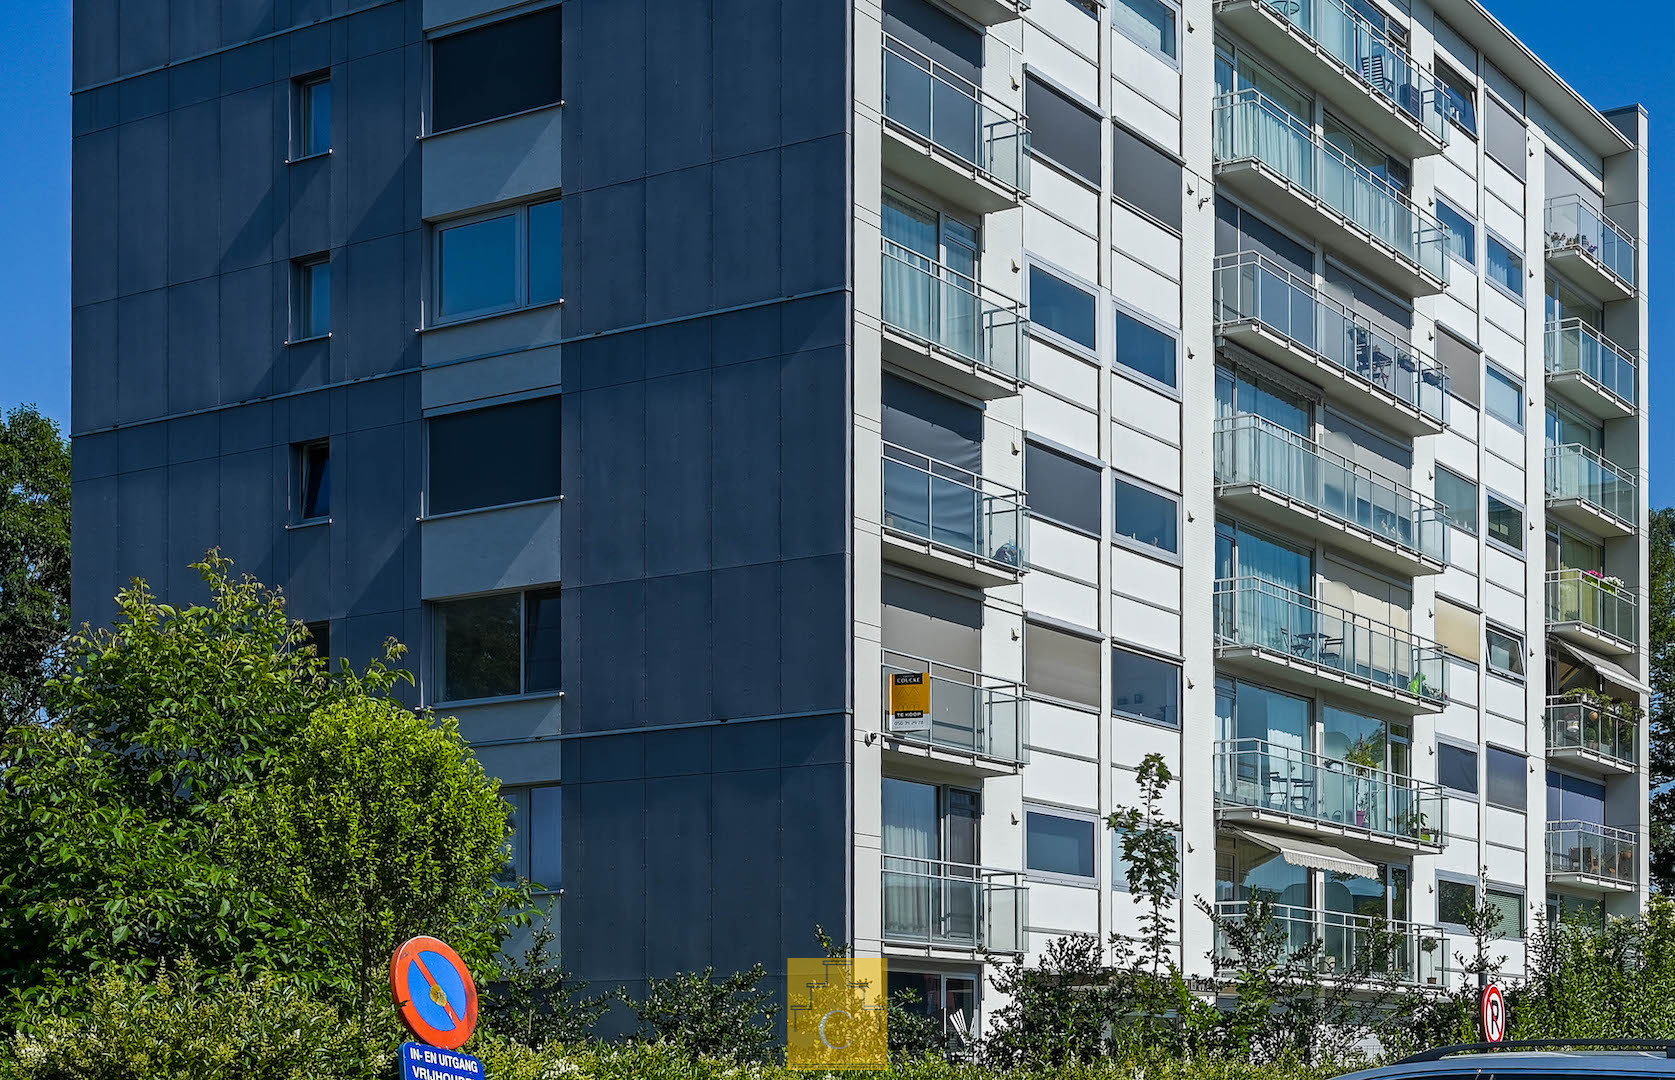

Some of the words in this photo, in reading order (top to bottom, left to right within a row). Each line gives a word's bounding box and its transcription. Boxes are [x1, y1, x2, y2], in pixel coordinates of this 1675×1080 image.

[410, 1047, 423, 1060] IN-
[424, 1050, 437, 1064] EN
[438, 1053, 478, 1073] UITGANG
[412, 1065, 474, 1080] VRIJHO
